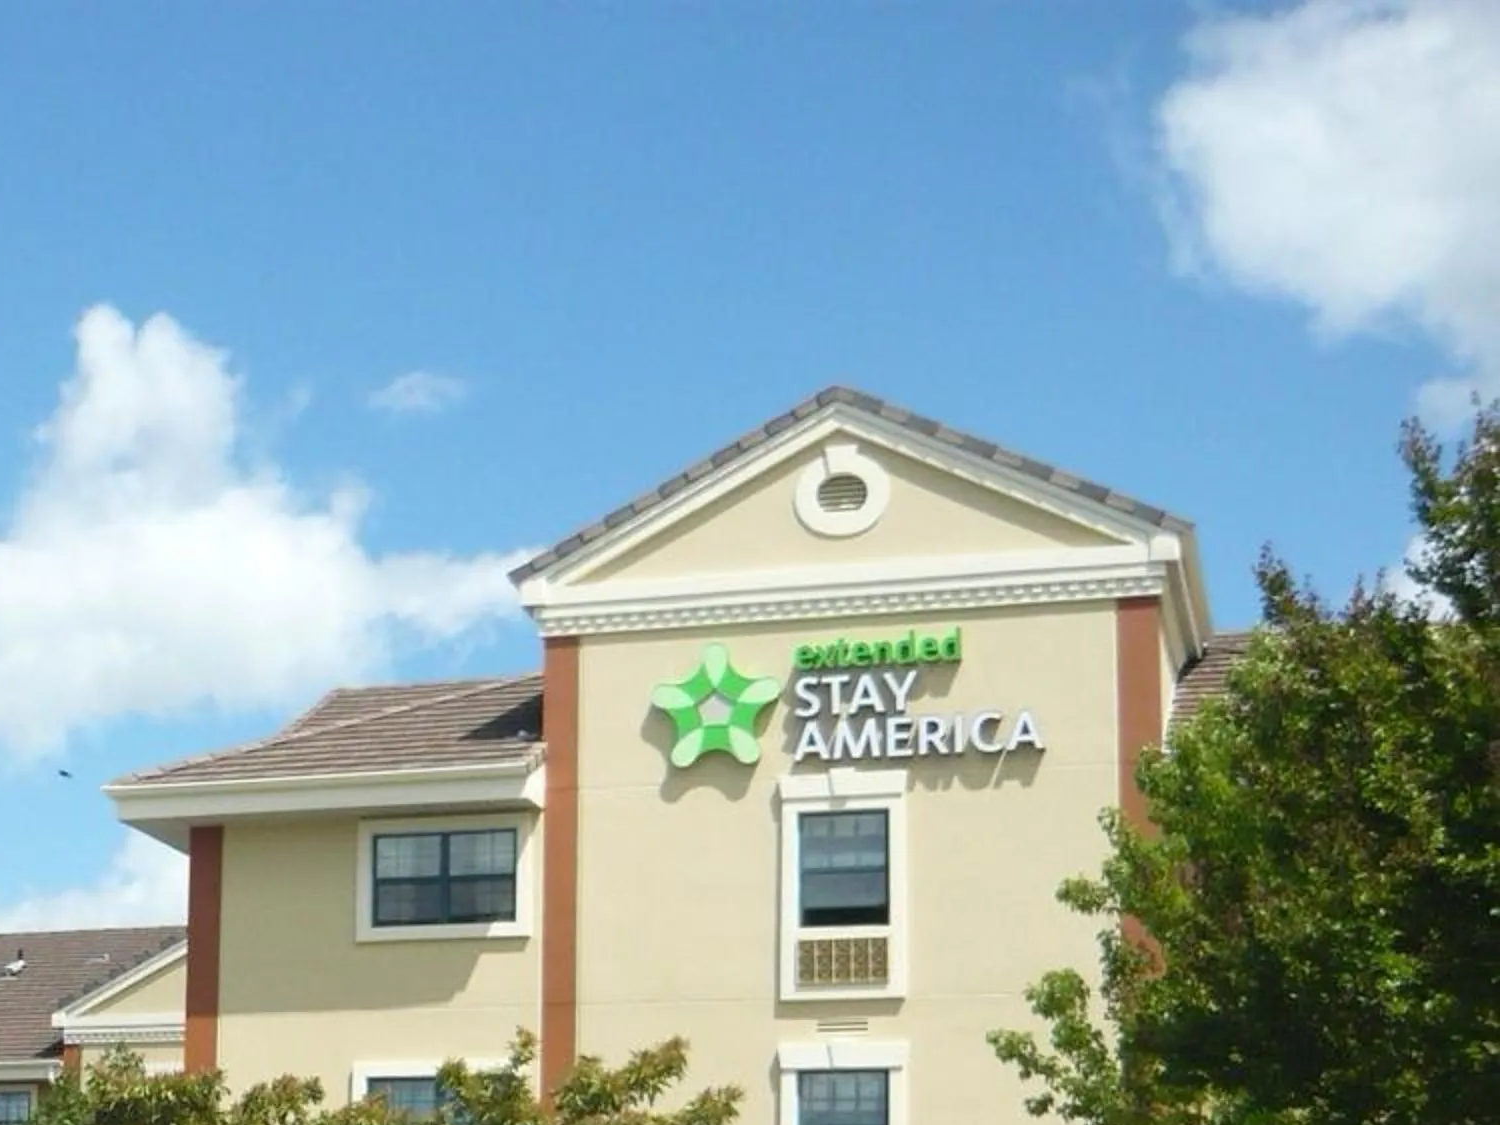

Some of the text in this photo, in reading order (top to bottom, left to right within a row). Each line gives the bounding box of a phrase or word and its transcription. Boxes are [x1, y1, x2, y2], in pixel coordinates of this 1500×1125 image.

[793, 626, 962, 668] extended
[794, 670, 917, 717] STAY
[794, 711, 1045, 761] AMERICA
